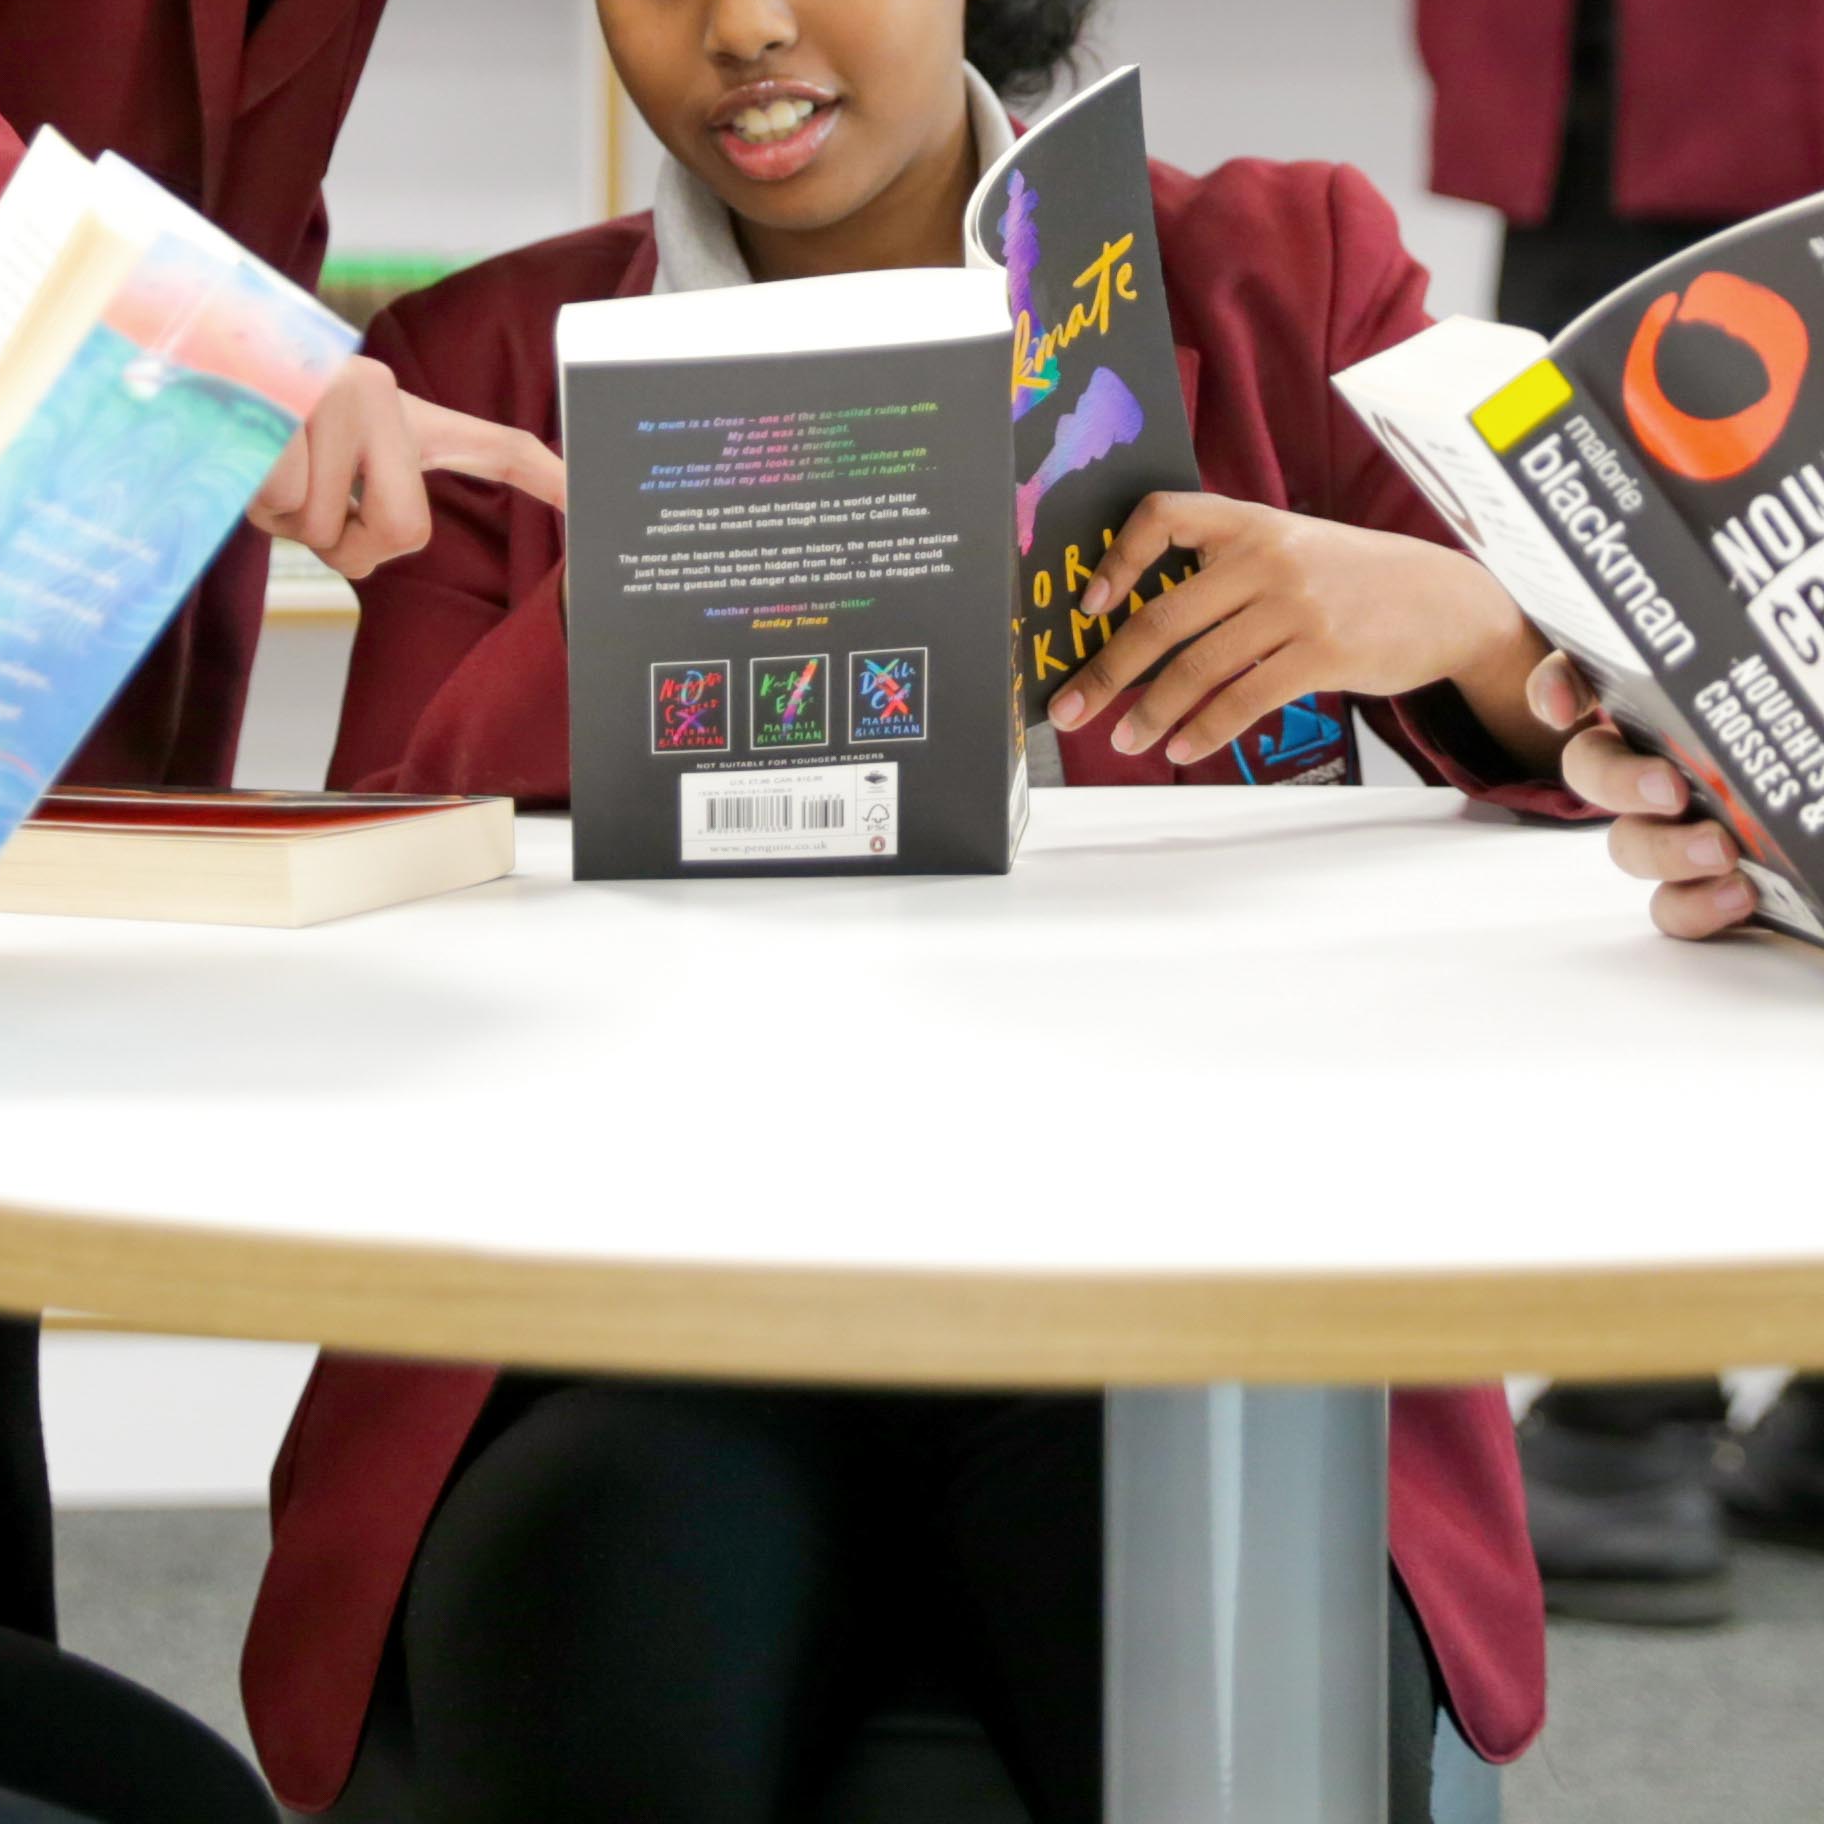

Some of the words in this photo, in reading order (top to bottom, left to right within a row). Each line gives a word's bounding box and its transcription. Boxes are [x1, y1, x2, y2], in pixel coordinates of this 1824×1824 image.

[1565, 415, 1644, 511] malorie
[660, 508, 703, 518] Growing
[707, 508, 719, 517] up
[723, 505, 745, 514] with
[748, 504, 770, 513] dual
[774, 501, 817, 512] heritage
[820, 499, 830, 508] in
[833, 499, 840, 508] a
[843, 496, 872, 507] world
[875, 495, 885, 504] of
[889, 493, 917, 503] bitter
[646, 523, 695, 535] prejudice
[699, 522, 717, 530] has
[721, 519, 752, 529] meant
[756, 517, 783, 527] some
[787, 515, 816, 526] tough
[820, 513, 848, 523] times
[851, 511, 866, 520] for
[869, 509, 898, 519] Callie
[902, 507, 930, 517] Rose.
[619, 554, 638, 564] The
[641, 553, 668, 562] more
[671, 552, 689, 561] she
[693, 551, 725, 560] learns
[729, 548, 757, 558] about
[761, 547, 778, 556] her
[782, 546, 802, 554] own
[847, 540, 864, 550] the
[867, 538, 893, 548] more
[897, 537, 915, 546] she
[918, 533, 959, 544] realizes
[1518, 433, 1696, 667] blackman
[624, 583, 652, 592] never
[656, 581, 680, 591] have
[684, 578, 726, 591] guessed
[730, 577, 746, 587] the
[750, 576, 785, 587] danger
[789, 573, 807, 583] she
[811, 572, 820, 582] is
[823, 570, 852, 581] about
[856, 569, 866, 578] to
[869, 568, 882, 577] be
[886, 565, 927, 577] dragged
[931, 563, 954, 573] into.
[635, 568, 654, 579] just
[658, 568, 679, 577] how
[683, 565, 710, 575] much
[714, 564, 732, 573] has
[736, 562, 761, 571] been
[765, 559, 800, 570] hidden
[803, 558, 826, 568] from
[830, 557, 847, 566] her
[872, 553, 889, 563] But
[893, 551, 911, 561] she
[914, 549, 943, 559] could
[752, 619, 792, 629] Sunday
[797, 616, 828, 626] Times
[753, 602, 807, 614] emotional
[1694, 679, 1801, 809] CROSSES
[719, 760, 764, 768] SUITABLE
[791, 756, 837, 765] YOUNGER
[840, 753, 884, 762] READERS
